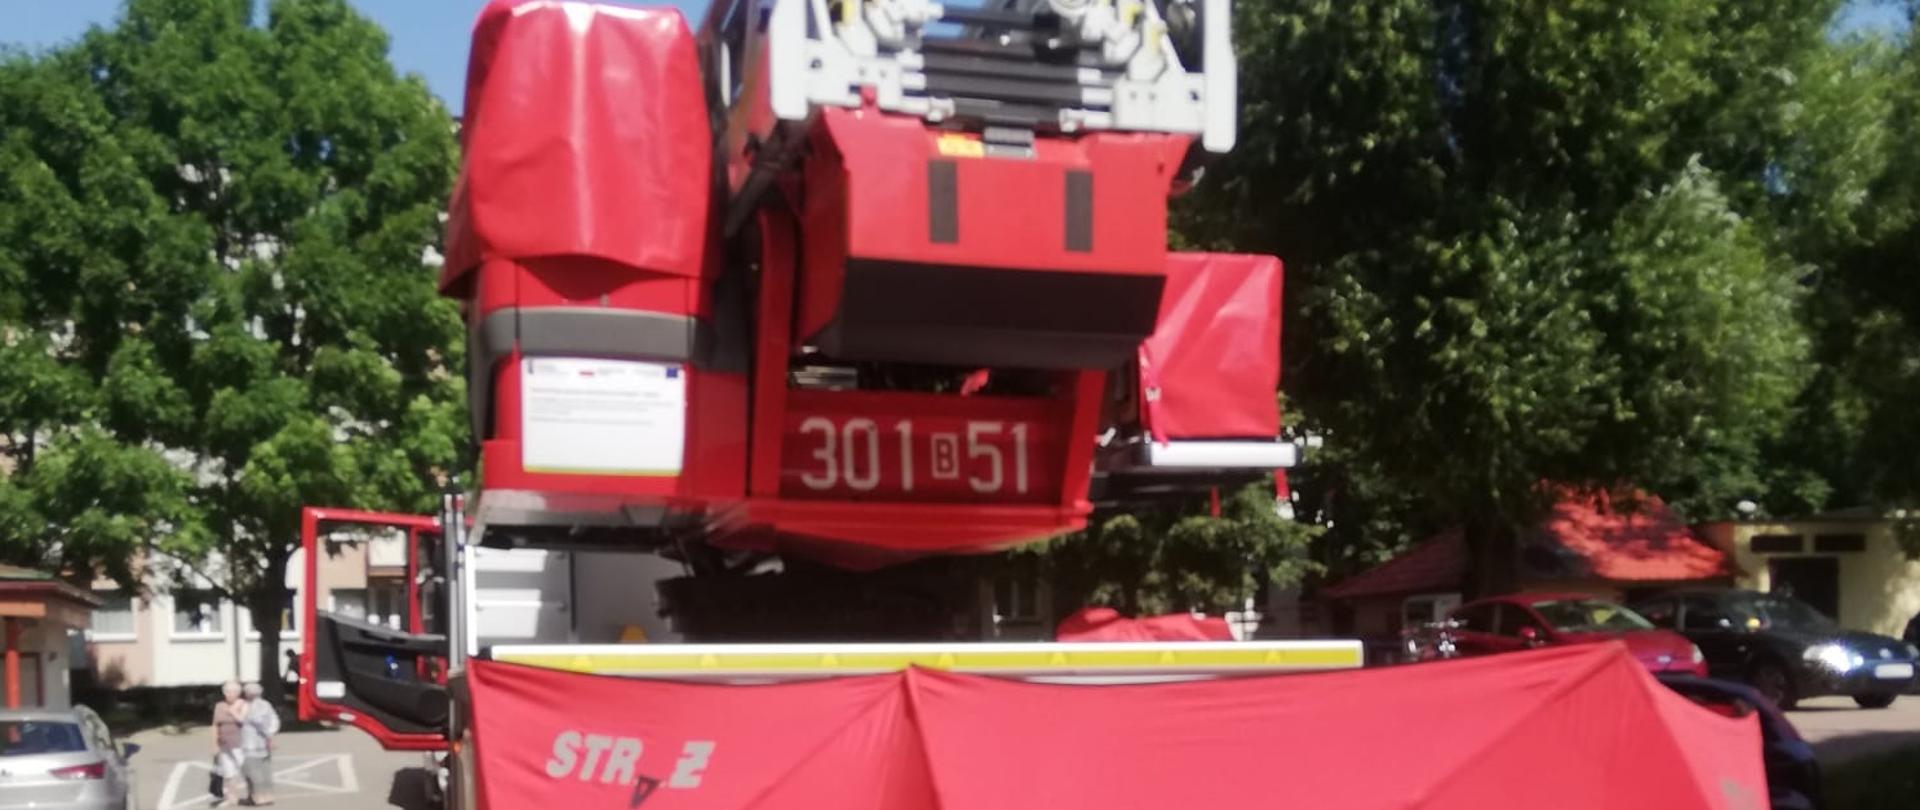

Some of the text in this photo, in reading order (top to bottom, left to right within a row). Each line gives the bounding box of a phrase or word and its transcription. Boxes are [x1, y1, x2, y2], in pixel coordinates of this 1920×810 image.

[800, 417, 1028, 494] 301 B 51
